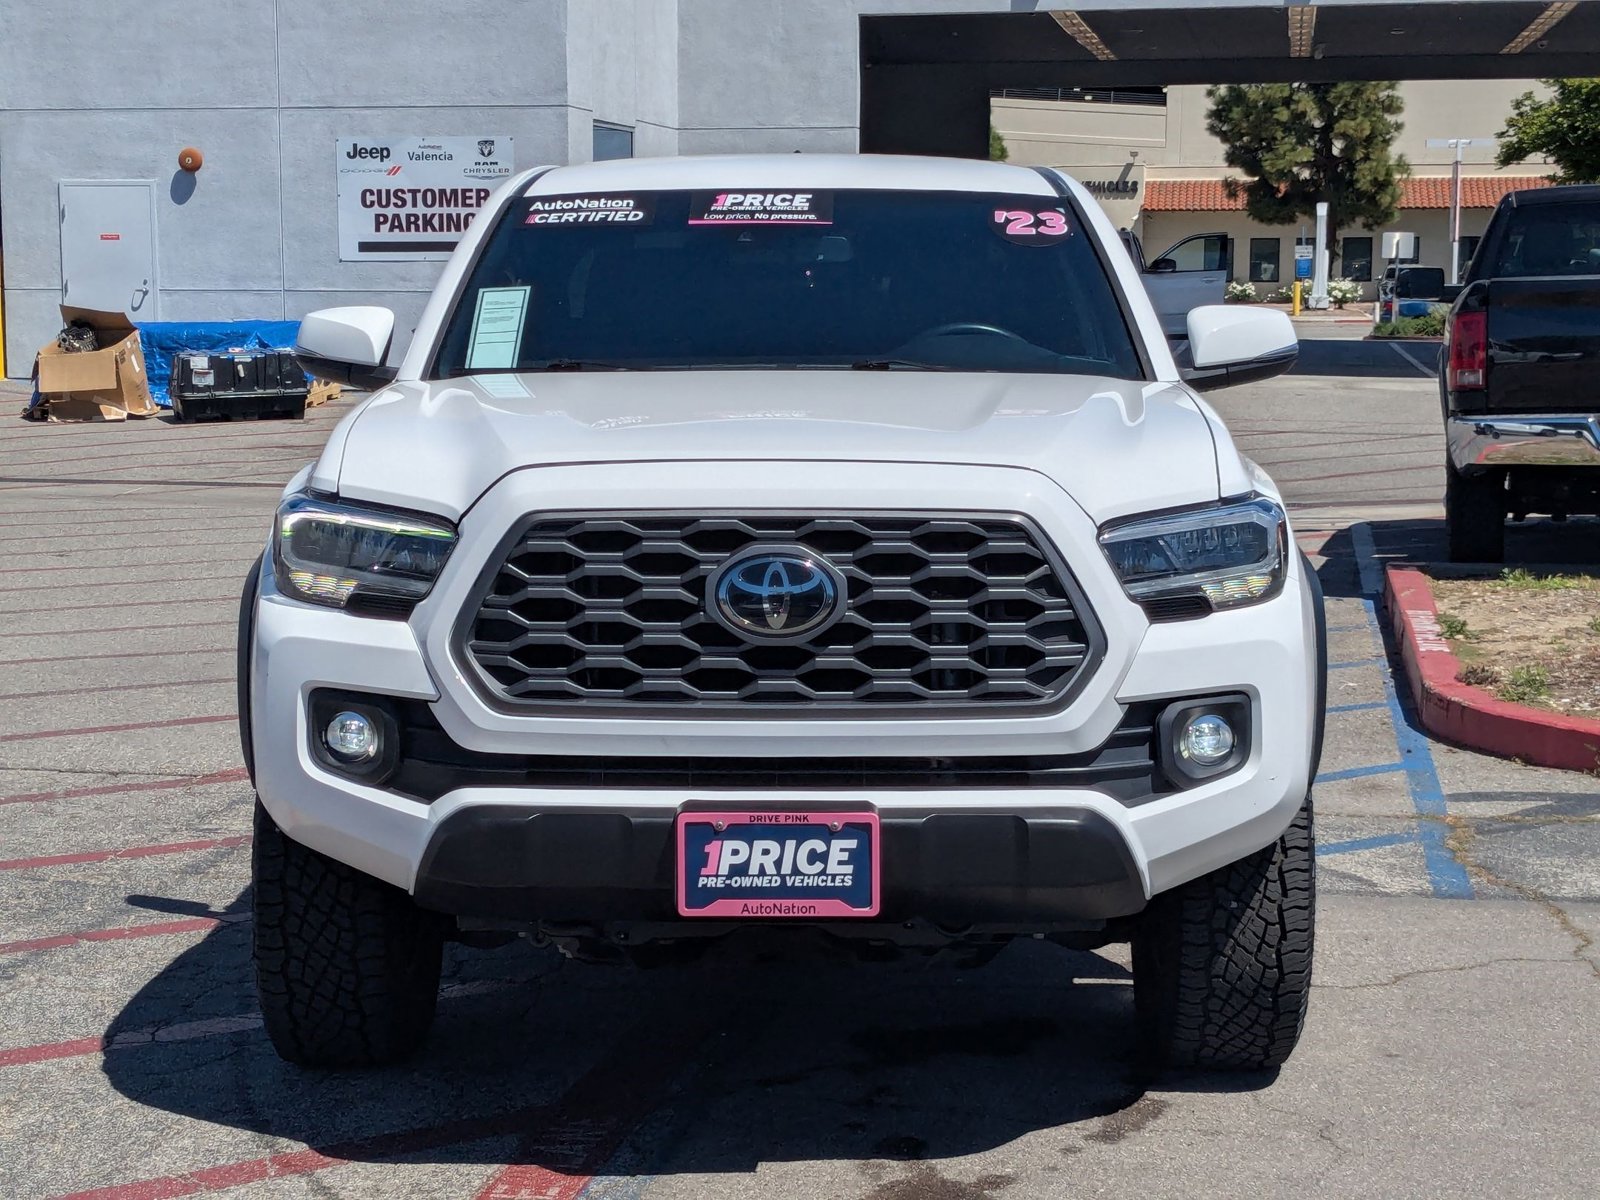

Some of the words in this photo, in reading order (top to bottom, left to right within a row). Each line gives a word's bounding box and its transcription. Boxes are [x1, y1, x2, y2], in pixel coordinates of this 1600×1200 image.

[346, 143, 391, 163] Jeep
[407, 151, 453, 161] Valencia
[529, 198, 635, 212] AutoNation
[534, 211, 644, 224] CERTIFIED
[749, 815, 780, 823] DRIVE
[784, 815, 810, 823] PINK
[697, 876, 781, 888] PRE-OWNED
[785, 875, 853, 887] VEHICLES
[741, 903, 816, 915] AutoNation
